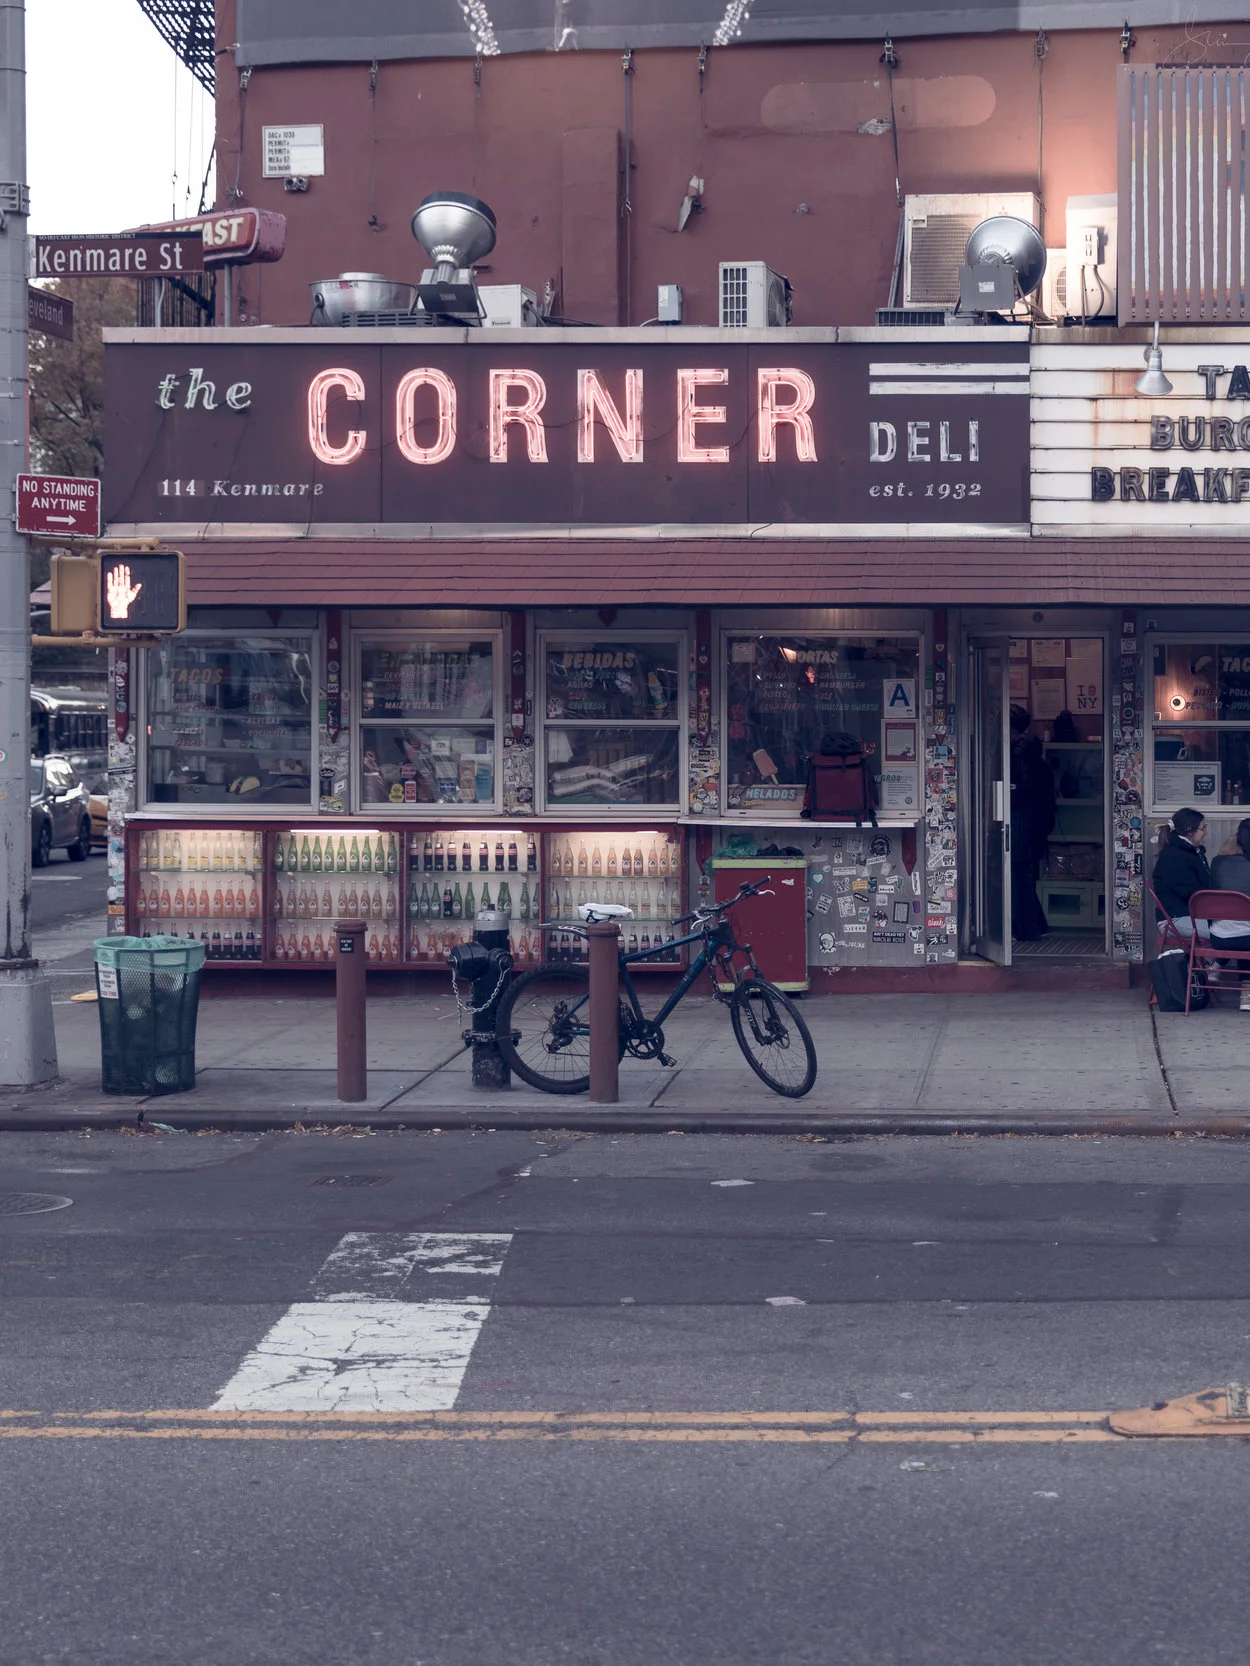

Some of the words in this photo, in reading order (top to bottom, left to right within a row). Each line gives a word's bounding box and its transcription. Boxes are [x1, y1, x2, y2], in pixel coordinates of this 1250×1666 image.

[38, 246, 147, 272] Kenmare
[159, 242, 183, 270] St
[28, 299, 64, 326] eveland
[155, 368, 252, 411] the
[306, 366, 818, 466] CORNER
[869, 420, 980, 463] DELI
[22, 480, 38, 493] NO
[42, 481, 95, 498] STANDING
[161, 479, 197, 497] 114
[210, 479, 324, 497] Kenmare
[869, 482, 914, 498] est.
[924, 483, 982, 500] 1932
[31, 496, 87, 512] ANYTIME
[562, 652, 635, 669] BEBIDAS
[792, 650, 839, 664] ORTAS
[170, 667, 224, 684] TACOS
[889, 683, 911, 707] A
[1077, 685, 1086, 697] I
[1077, 697, 1098, 709] NY
[745, 788, 797, 800] HELADOS
